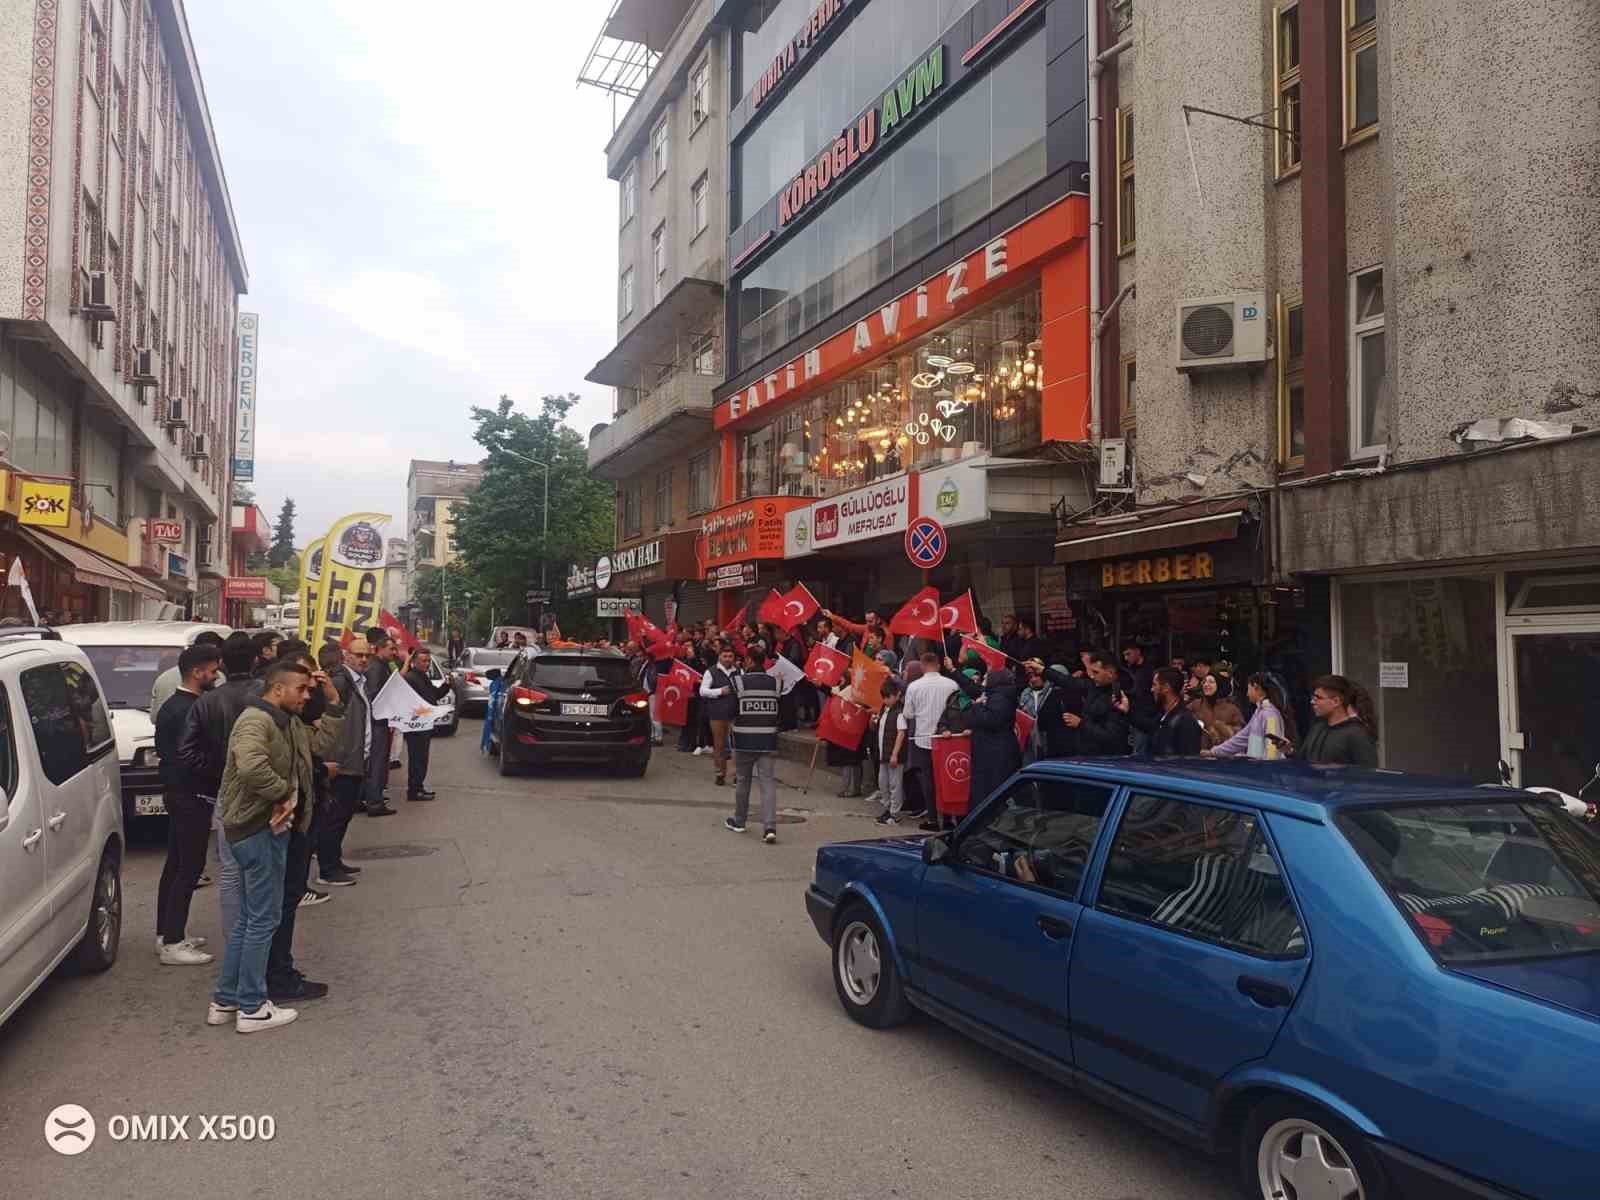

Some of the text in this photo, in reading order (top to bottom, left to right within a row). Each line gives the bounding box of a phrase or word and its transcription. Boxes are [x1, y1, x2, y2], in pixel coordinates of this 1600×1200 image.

[778, 44, 944, 226] KÖROĞLU AVM
[840, 486, 906, 517] GÜLLÜOĞLU
[1102, 552, 1213, 588] BERBER
